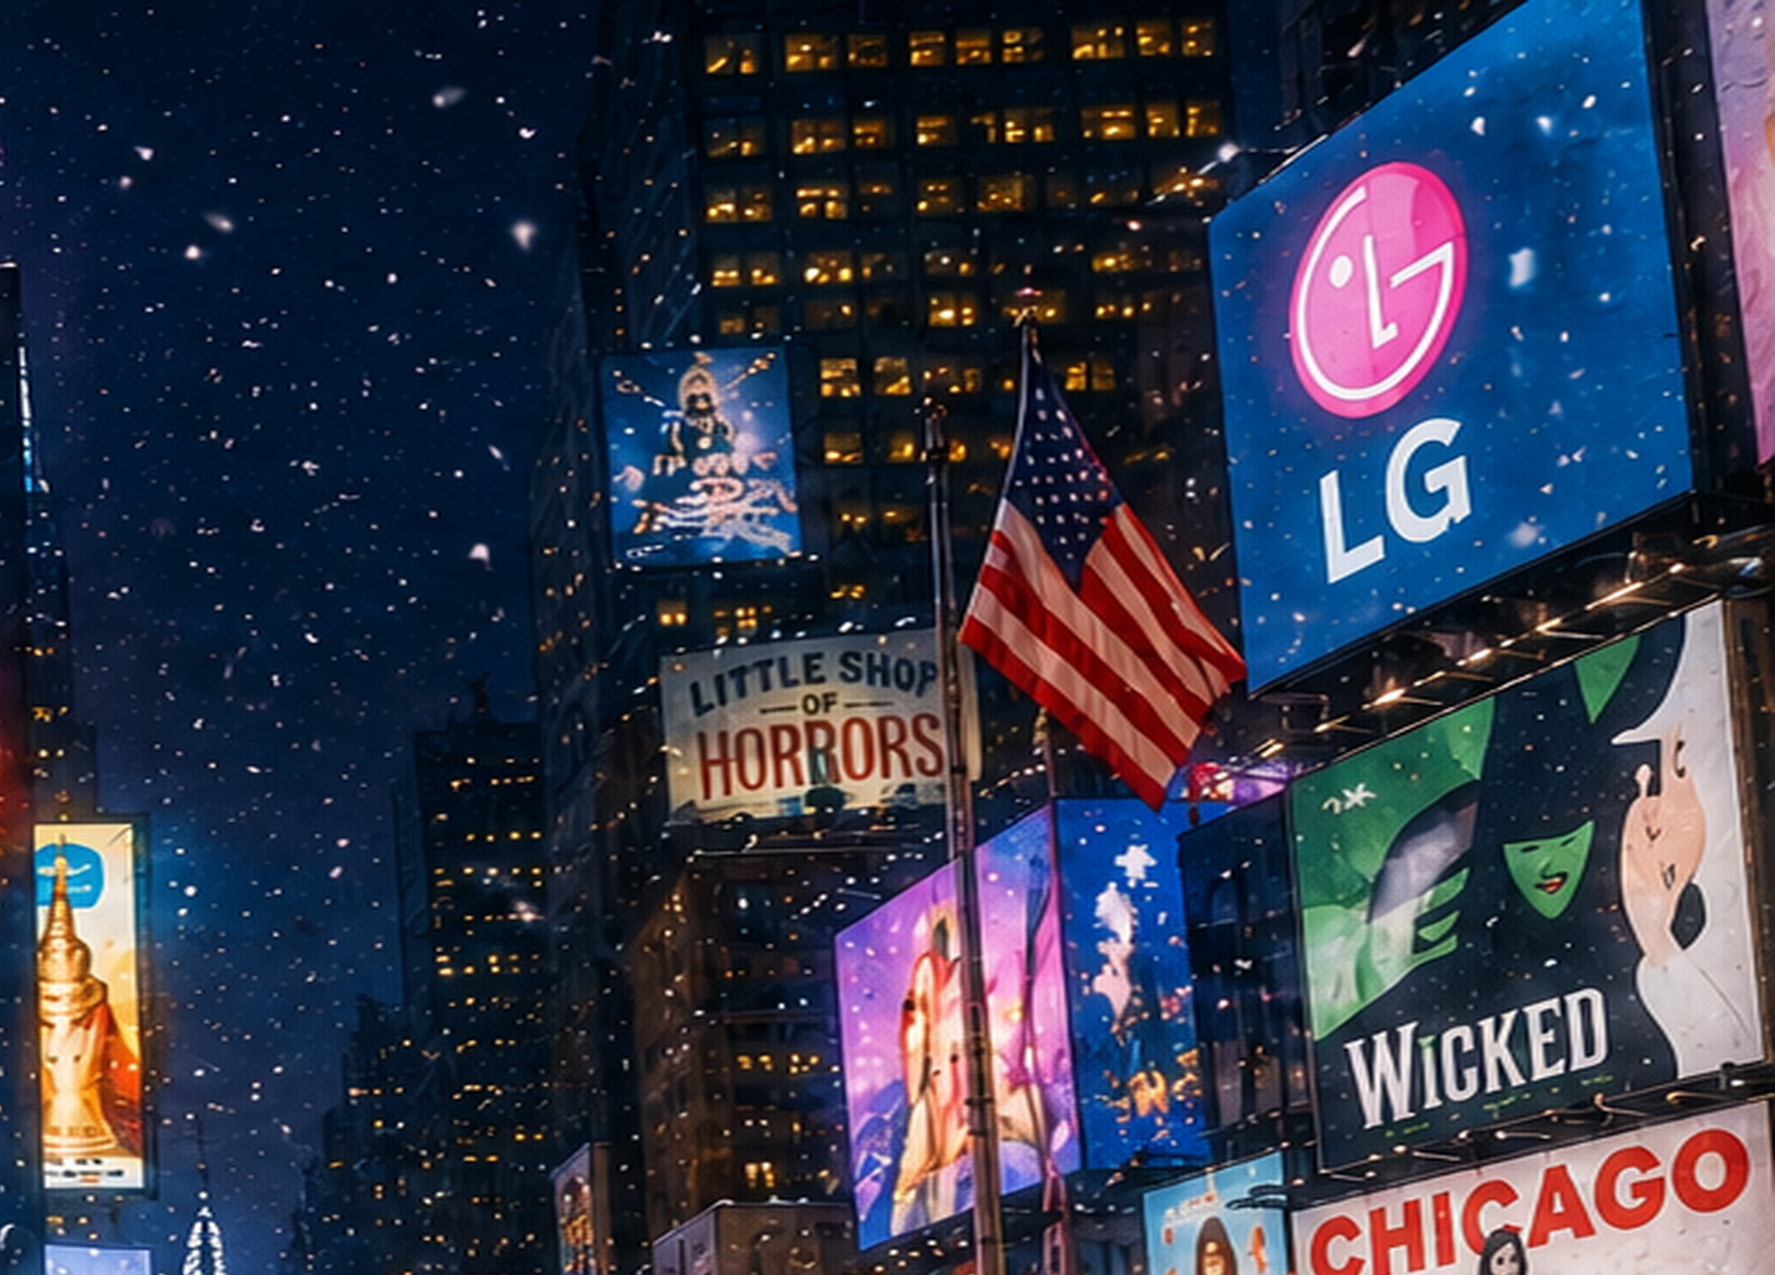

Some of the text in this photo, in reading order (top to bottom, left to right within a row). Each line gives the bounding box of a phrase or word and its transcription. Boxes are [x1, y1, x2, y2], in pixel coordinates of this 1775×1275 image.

[1319, 417, 1472, 584] LG
[689, 650, 938, 717] LITTLE SHOP
[801, 691, 839, 715] OF
[697, 713, 944, 801] HORRORS
